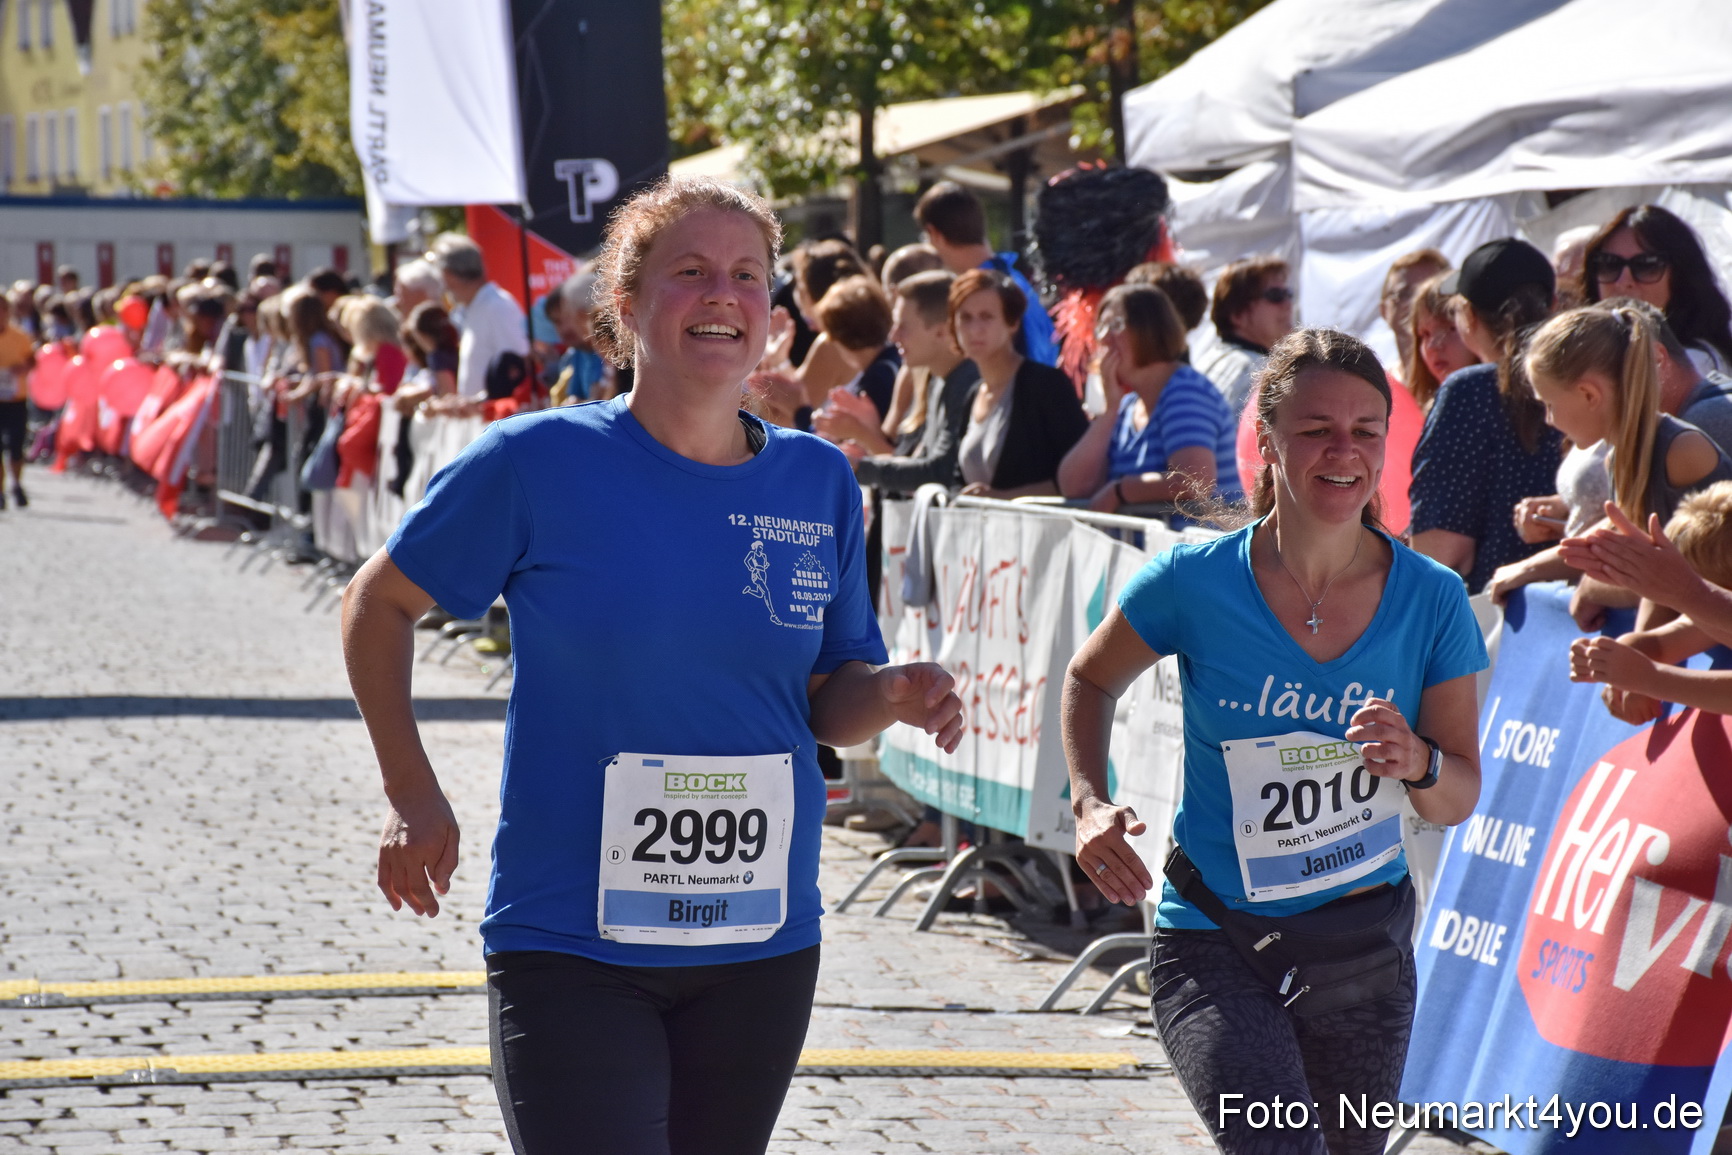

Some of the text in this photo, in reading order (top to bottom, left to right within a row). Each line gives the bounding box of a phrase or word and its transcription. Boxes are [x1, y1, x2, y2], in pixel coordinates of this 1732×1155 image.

[728, 513, 834, 537] 12. NEUMARKTER
[752, 527, 821, 547] STADTLAUF
[791, 590, 832, 602] 18.09.2011
[1279, 741, 1359, 766] BOCK
[1492, 719, 1561, 768] STORE
[1282, 765, 1305, 773] inspired
[664, 772, 748, 793] BOCK
[1260, 765, 1380, 833] 2010
[631, 807, 768, 865] 2999
[1245, 824, 1252, 834] D
[1277, 815, 1361, 848] PARTL Neumarkt
[1462, 813, 1536, 868] ONLINE
[612, 850, 620, 860] D
[1301, 841, 1366, 877] Janina
[643, 872, 739, 885] PARTL Neumarkt
[668, 899, 729, 928] Birgit
[1531, 938, 1595, 994] SPORTS
